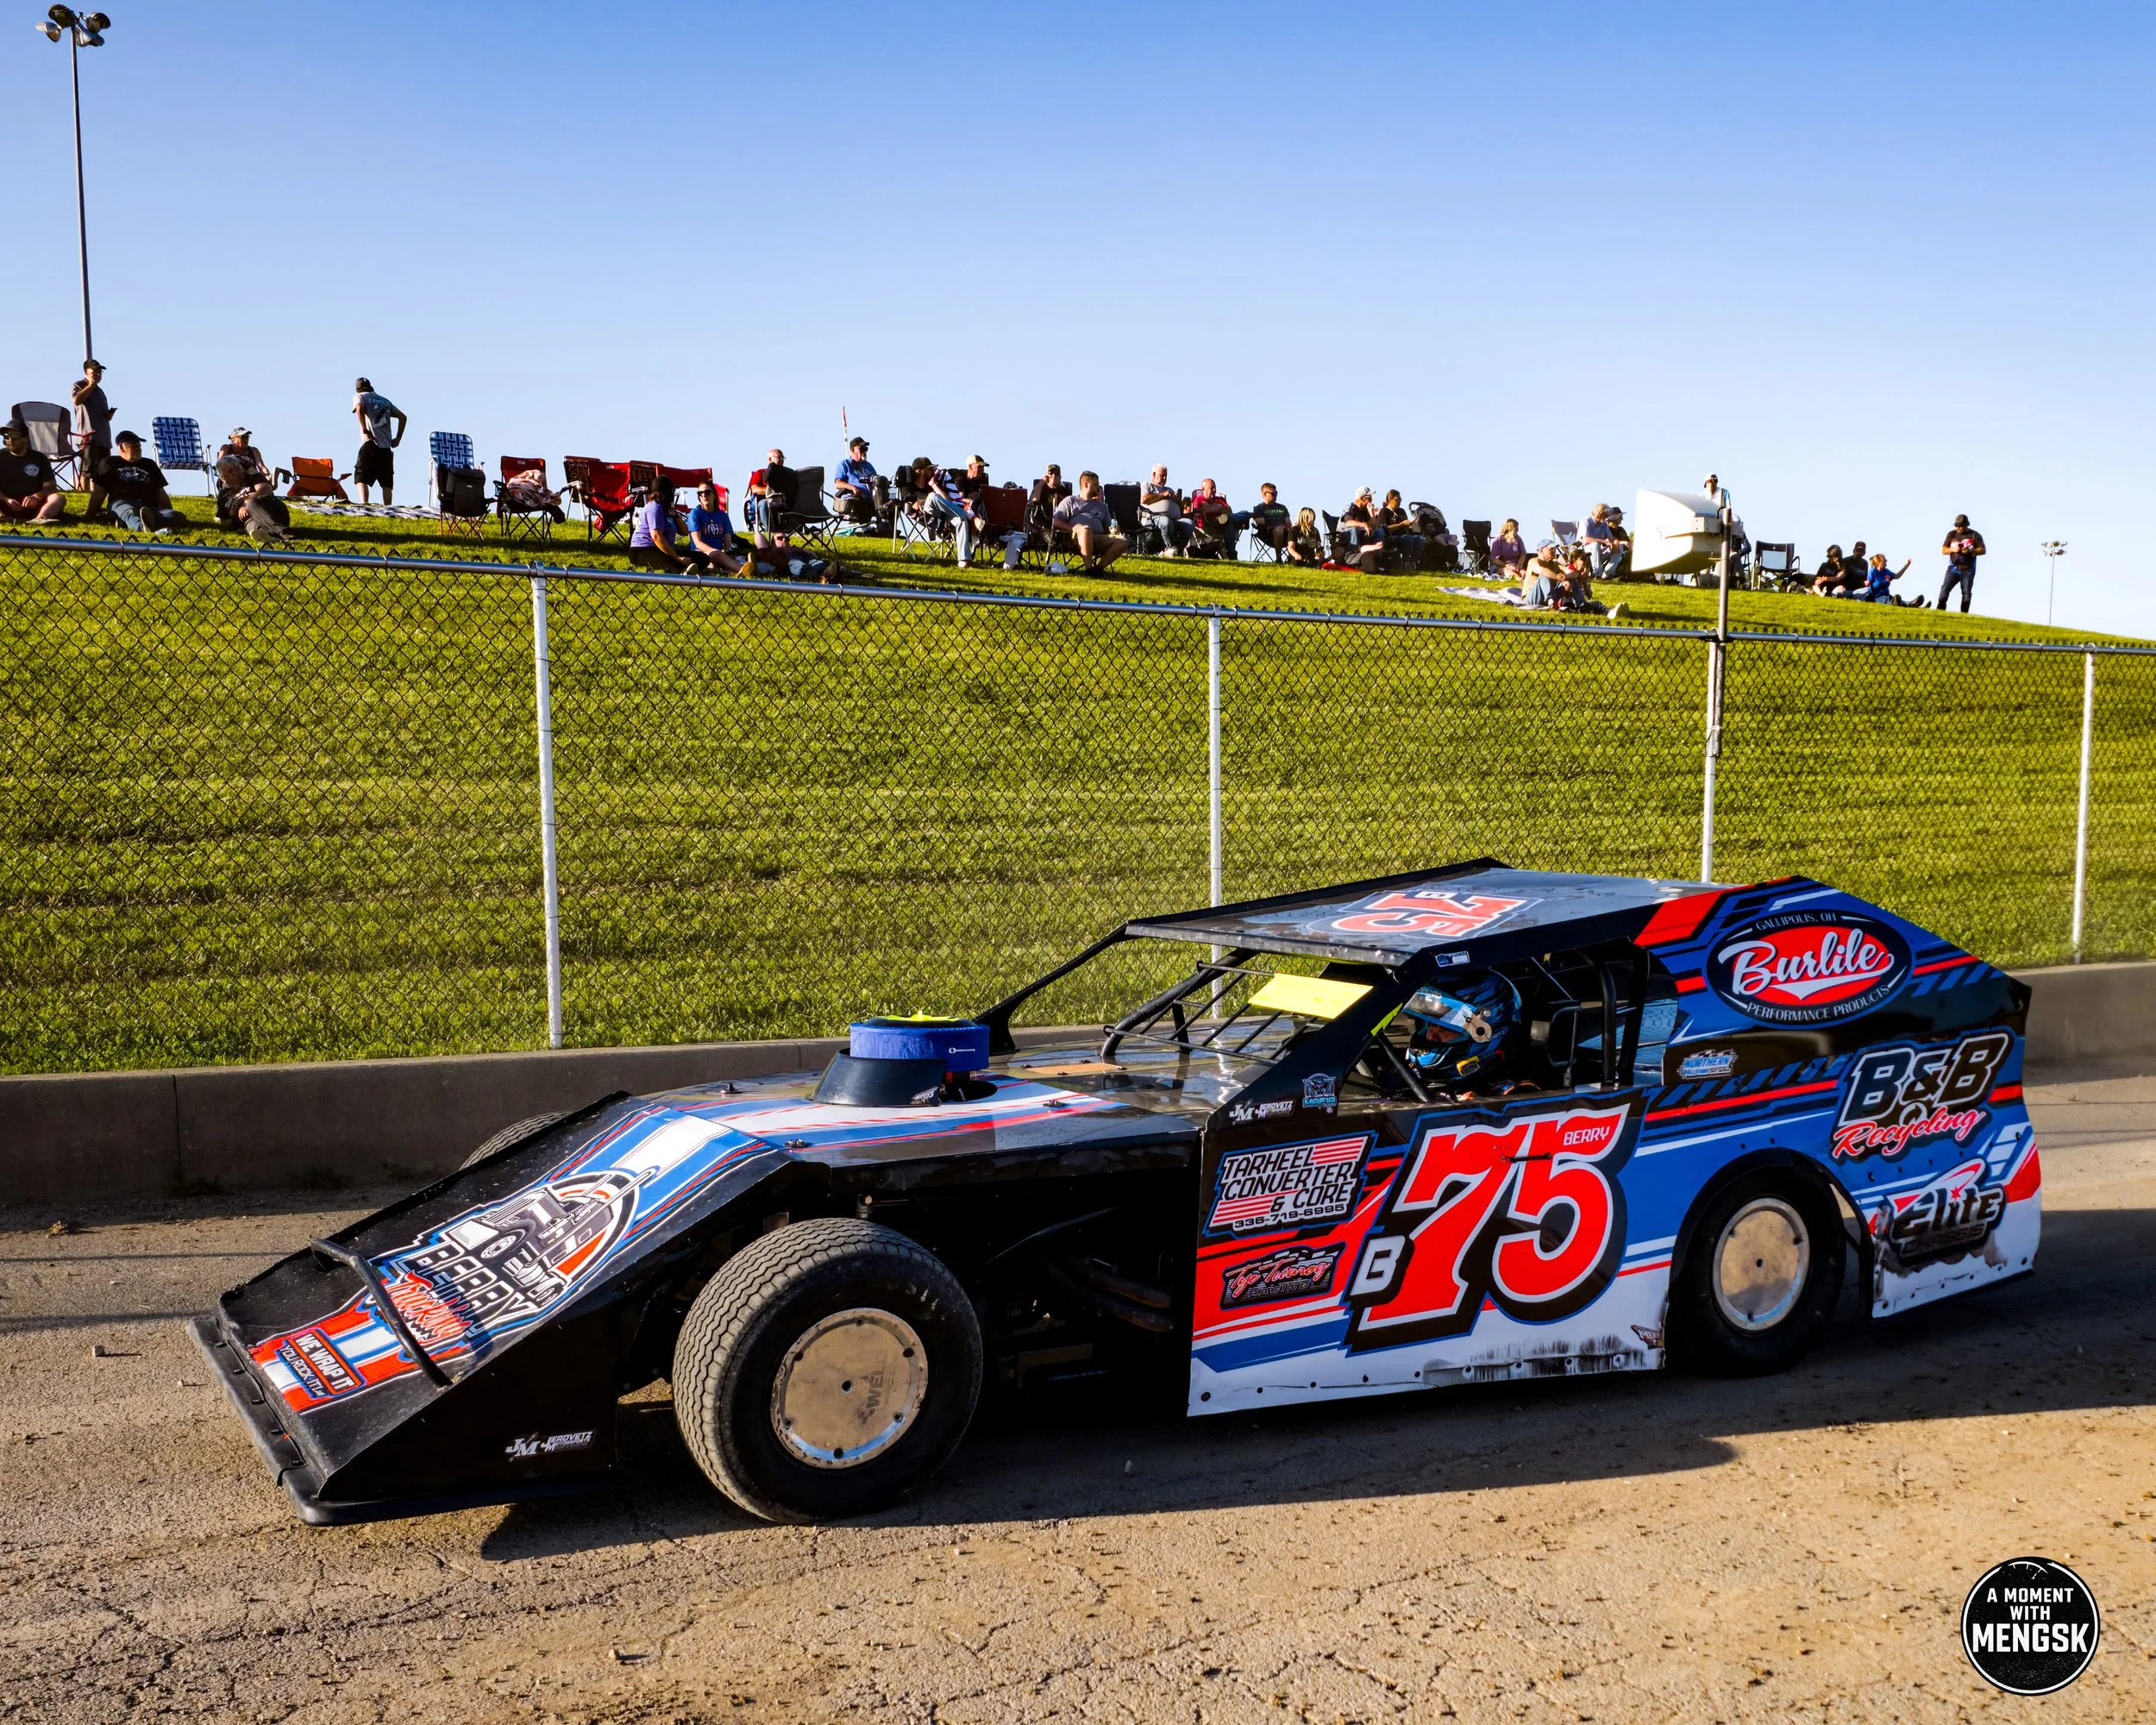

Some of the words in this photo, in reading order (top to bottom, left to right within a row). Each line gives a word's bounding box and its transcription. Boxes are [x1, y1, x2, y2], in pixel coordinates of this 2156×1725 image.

[1755, 913, 1818, 931] GALLIPOLIS,
[1821, 913, 1837, 921] OH
[1718, 928, 1890, 995] Burlile
[1747, 1002, 1832, 1021] PERFORMANCE
[1833, 984, 1890, 1016] PRODUCTS
[1838, 1033, 2009, 1126] B&B
[1304, 1097, 1336, 1106] MAFIA
[1563, 1126, 1610, 1145] BERRY
[1833, 1106, 1987, 1158] Recycling
[1225, 1146, 1315, 1180] TARHEEL
[1223, 1163, 1353, 1201] CONVERTER
[1270, 1196, 1285, 1212] &
[1294, 1182, 1353, 1208] CORE
[1234, 1204, 1345, 1228] 336-719-6995
[1357, 1103, 1631, 1332] 75
[1891, 1185, 2004, 1242] Elite
[1225, 1263, 1262, 1298] Tye
[1351, 1235, 1406, 1295] B
[392, 1240, 539, 1337] BERRY
[385, 1270, 473, 1346] Trucking
[279, 1345, 300, 1364] YOU
[291, 1358, 315, 1381] ROCK
[295, 1333, 323, 1352] WE
[309, 1348, 346, 1377] WRAP
[330, 1377, 355, 1390] IT
[505, 1438, 541, 1457] JM
[541, 1431, 593, 1449] JEROVETZ
